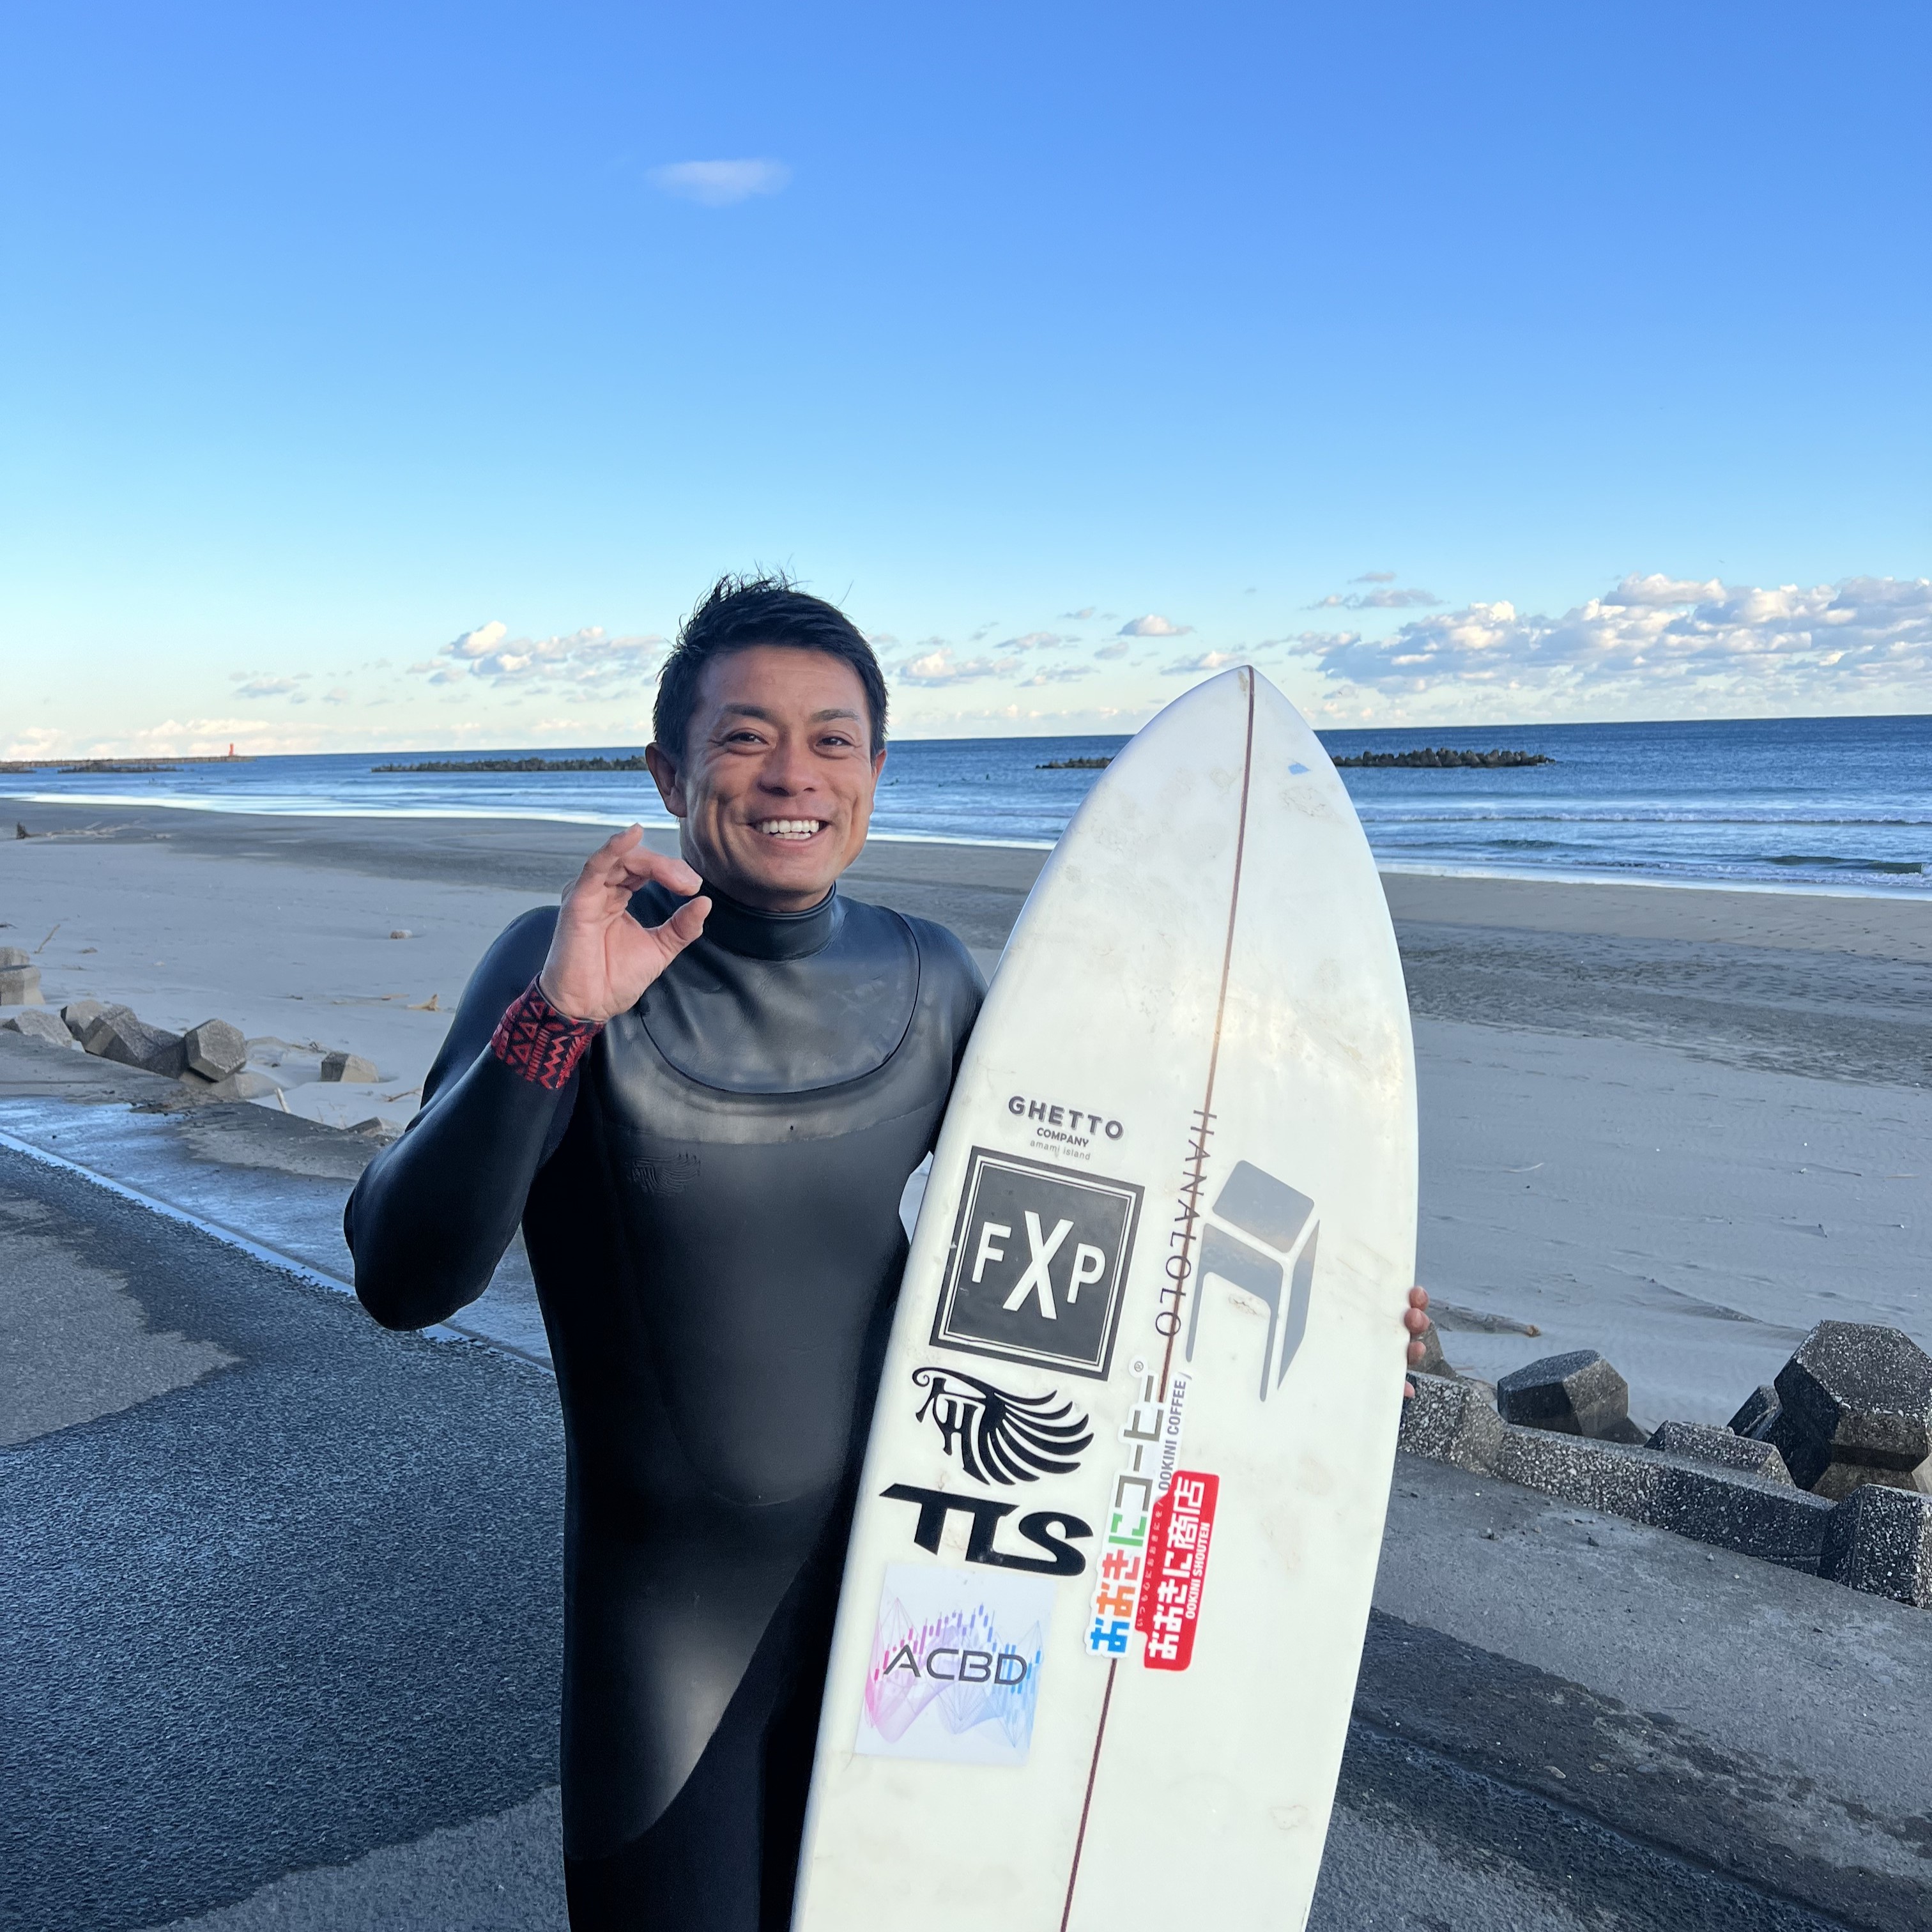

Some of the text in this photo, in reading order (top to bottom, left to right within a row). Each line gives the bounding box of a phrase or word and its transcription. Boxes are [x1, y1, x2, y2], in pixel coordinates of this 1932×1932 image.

[1008, 1096, 1124, 1140] GHETTO
[1030, 1140, 1091, 1161] amami island
[1037, 1128, 1089, 1147] COMPANY
[971, 1211, 1106, 1320] FXP
[1154, 1110, 1217, 1337] HANALOLO
[1158, 1380, 1186, 1492] OOKINI COFFEE
[879, 1483, 1094, 1576] TLS
[1091, 1375, 1164, 1653] おおきにコーヒー
[1149, 1476, 1205, 1660] おおきに商店
[1185, 1522, 1211, 1620] OOKINI SHOUTEN
[883, 1644, 1028, 1685] ACBD
